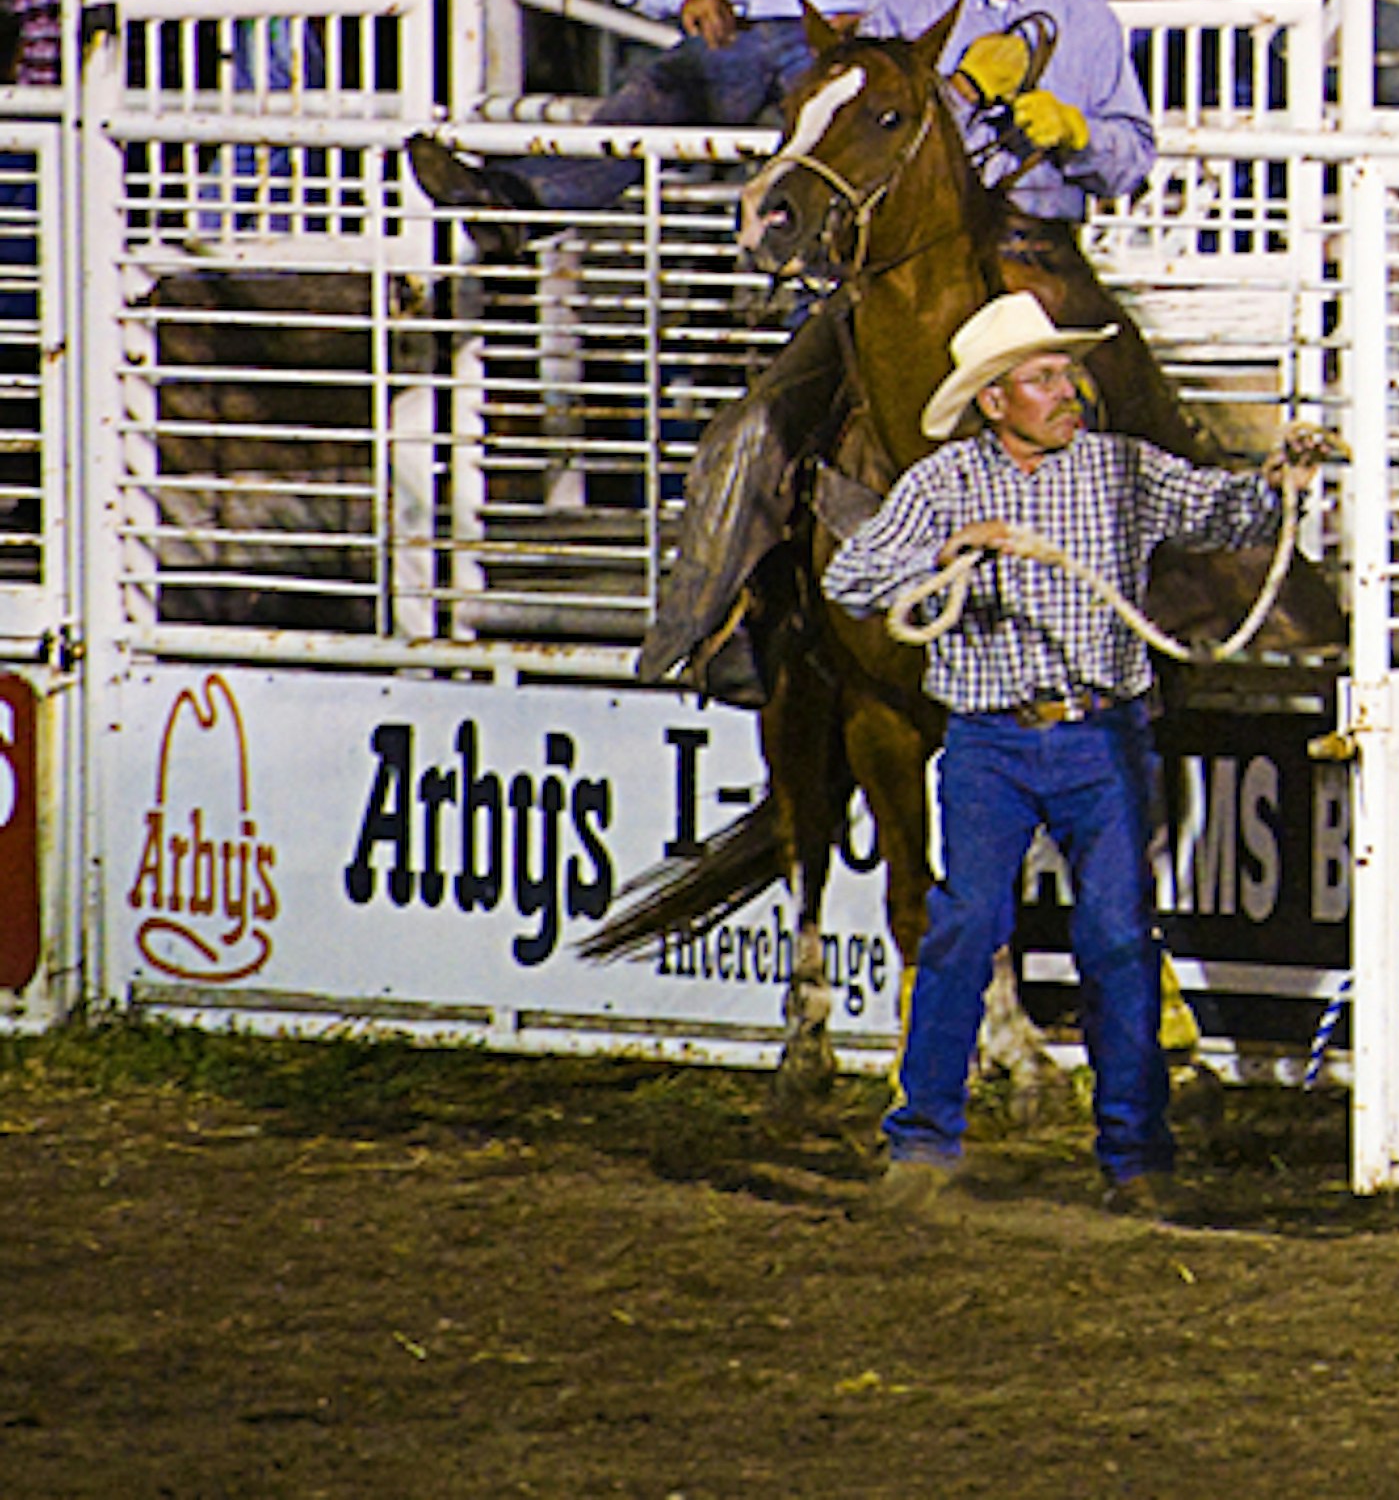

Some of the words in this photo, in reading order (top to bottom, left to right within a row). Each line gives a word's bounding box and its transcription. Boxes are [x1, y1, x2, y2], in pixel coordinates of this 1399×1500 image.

[128, 808, 280, 945] Arby's
[345, 719, 614, 966] Arby's
[656, 905, 887, 1016] Interchnge
